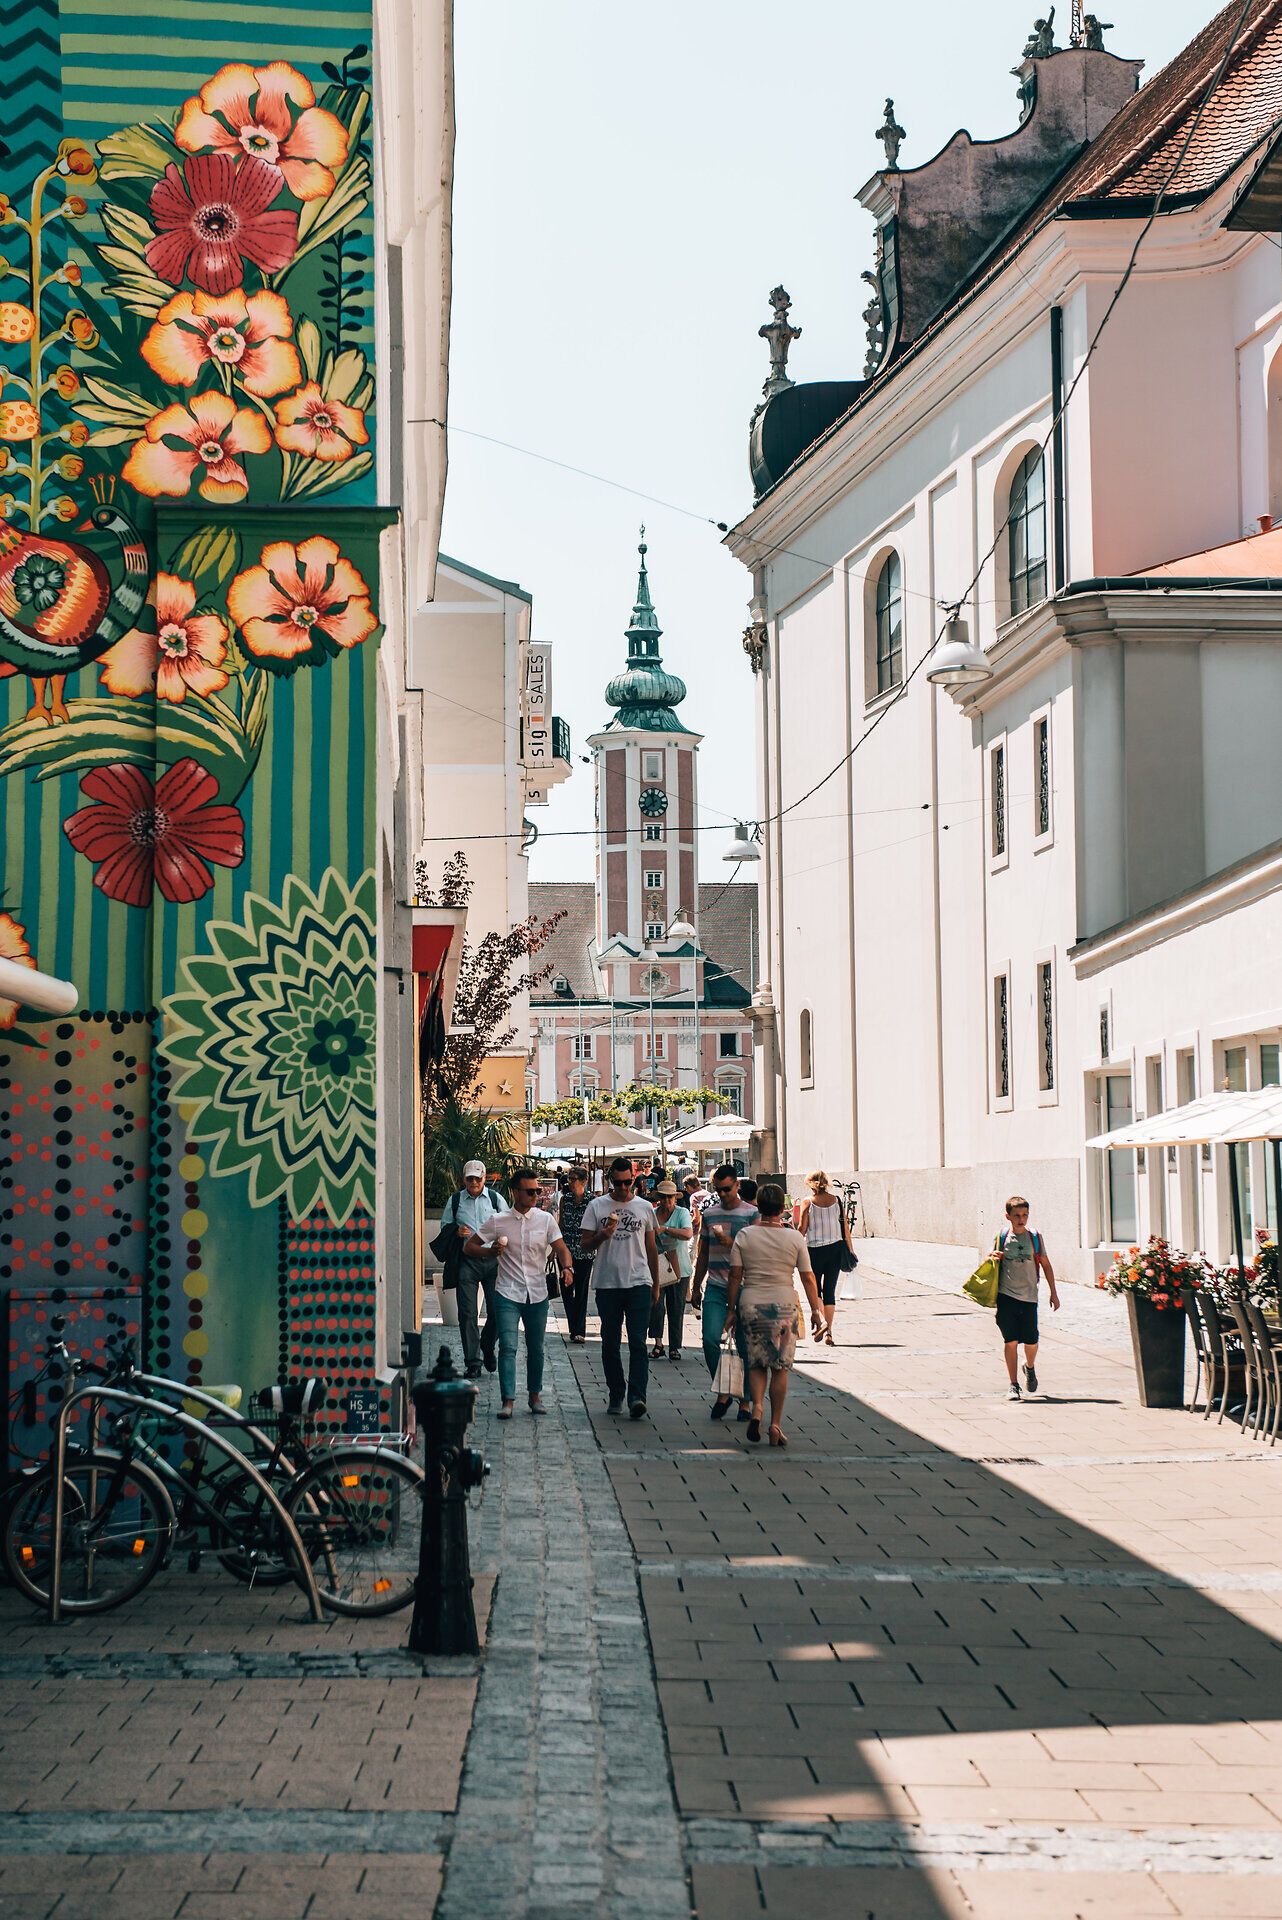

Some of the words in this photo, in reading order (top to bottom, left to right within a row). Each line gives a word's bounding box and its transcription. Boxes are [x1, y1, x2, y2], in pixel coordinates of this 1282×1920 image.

[530, 655, 543, 704] SALES
[528, 730, 547, 757] sig
[621, 1215, 642, 1231] York
[350, 1400, 363, 1410] HS
